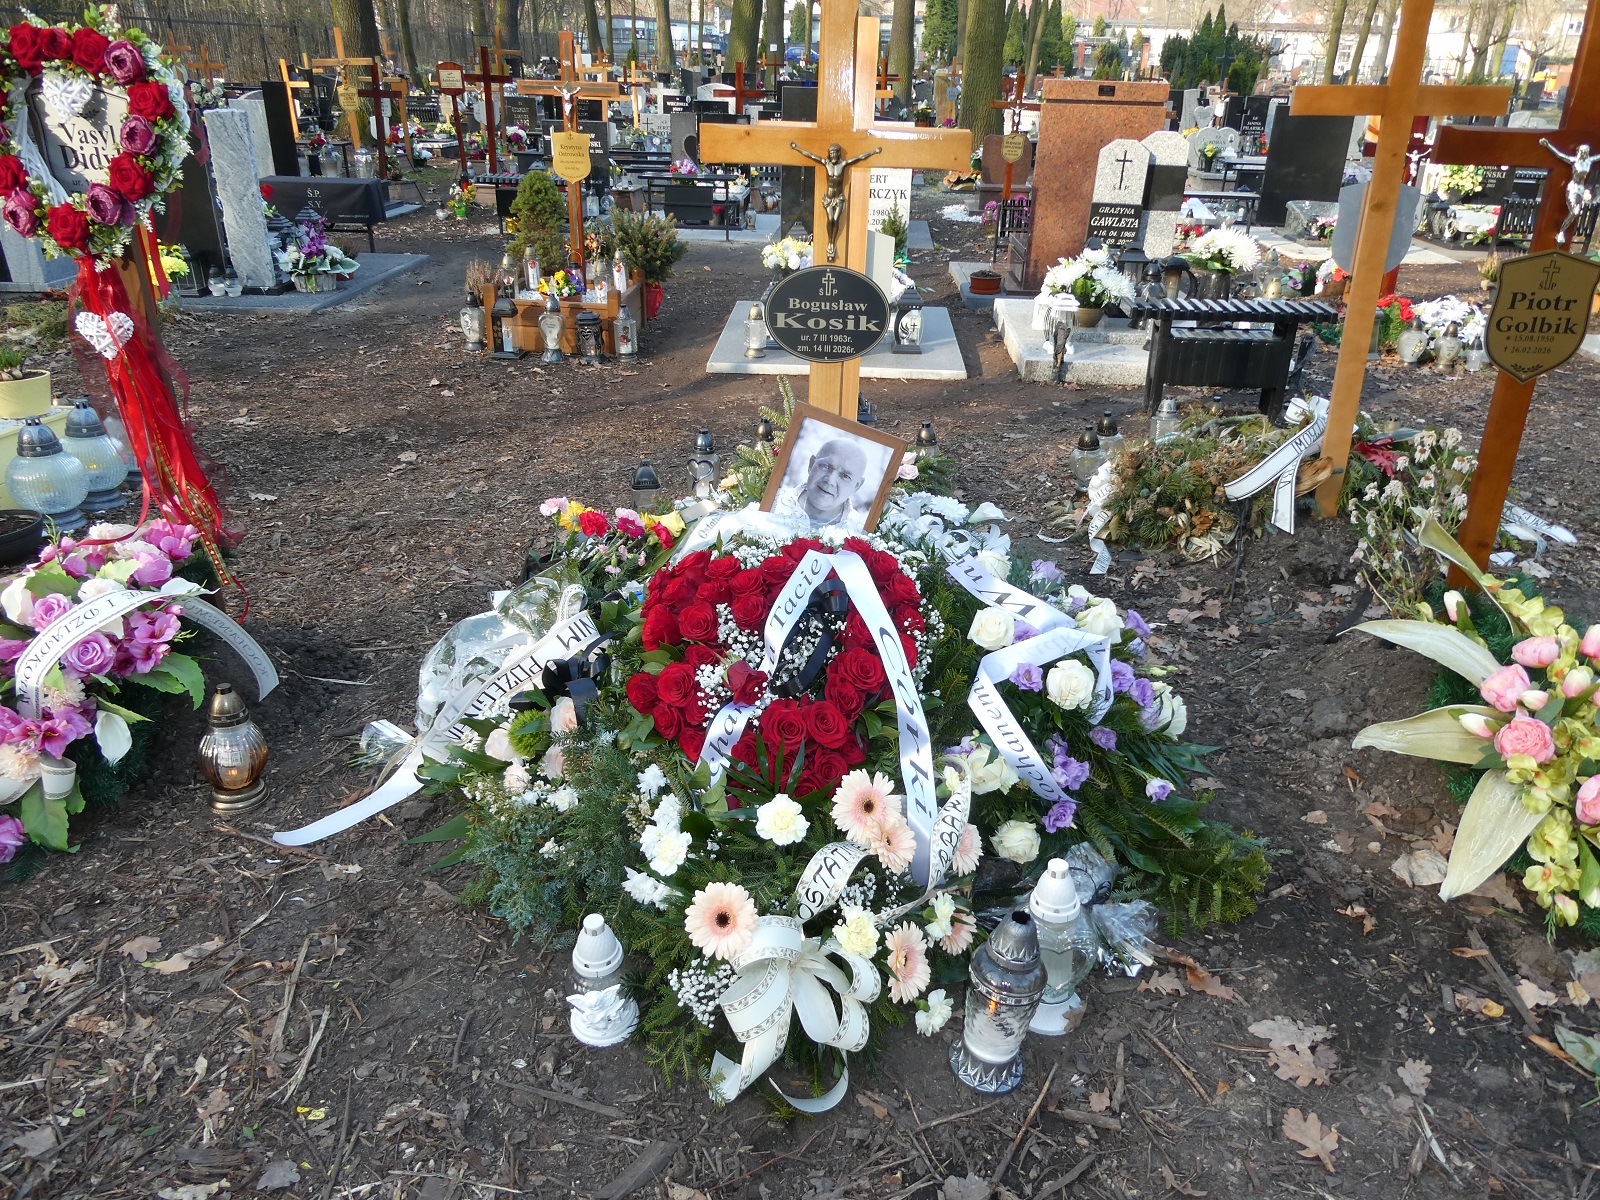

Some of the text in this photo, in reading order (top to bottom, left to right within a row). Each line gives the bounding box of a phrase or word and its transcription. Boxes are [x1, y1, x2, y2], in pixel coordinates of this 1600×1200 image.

[59, 122, 117, 151] Vasyl
[1098, 206, 1135, 215] GRAŻYNA
[1090, 216, 1139, 228] GAWLETA
[788, 297, 868, 312] Bogusław
[1507, 291, 1578, 312] Piotr
[774, 312, 881, 331] Kosik
[1495, 316, 1579, 335] Golbik
[829, 334, 853, 343] 1963r.
[813, 345, 822, 353] 14
[832, 345, 856, 354] 2026r.
[769, 556, 823, 631] Tacie
